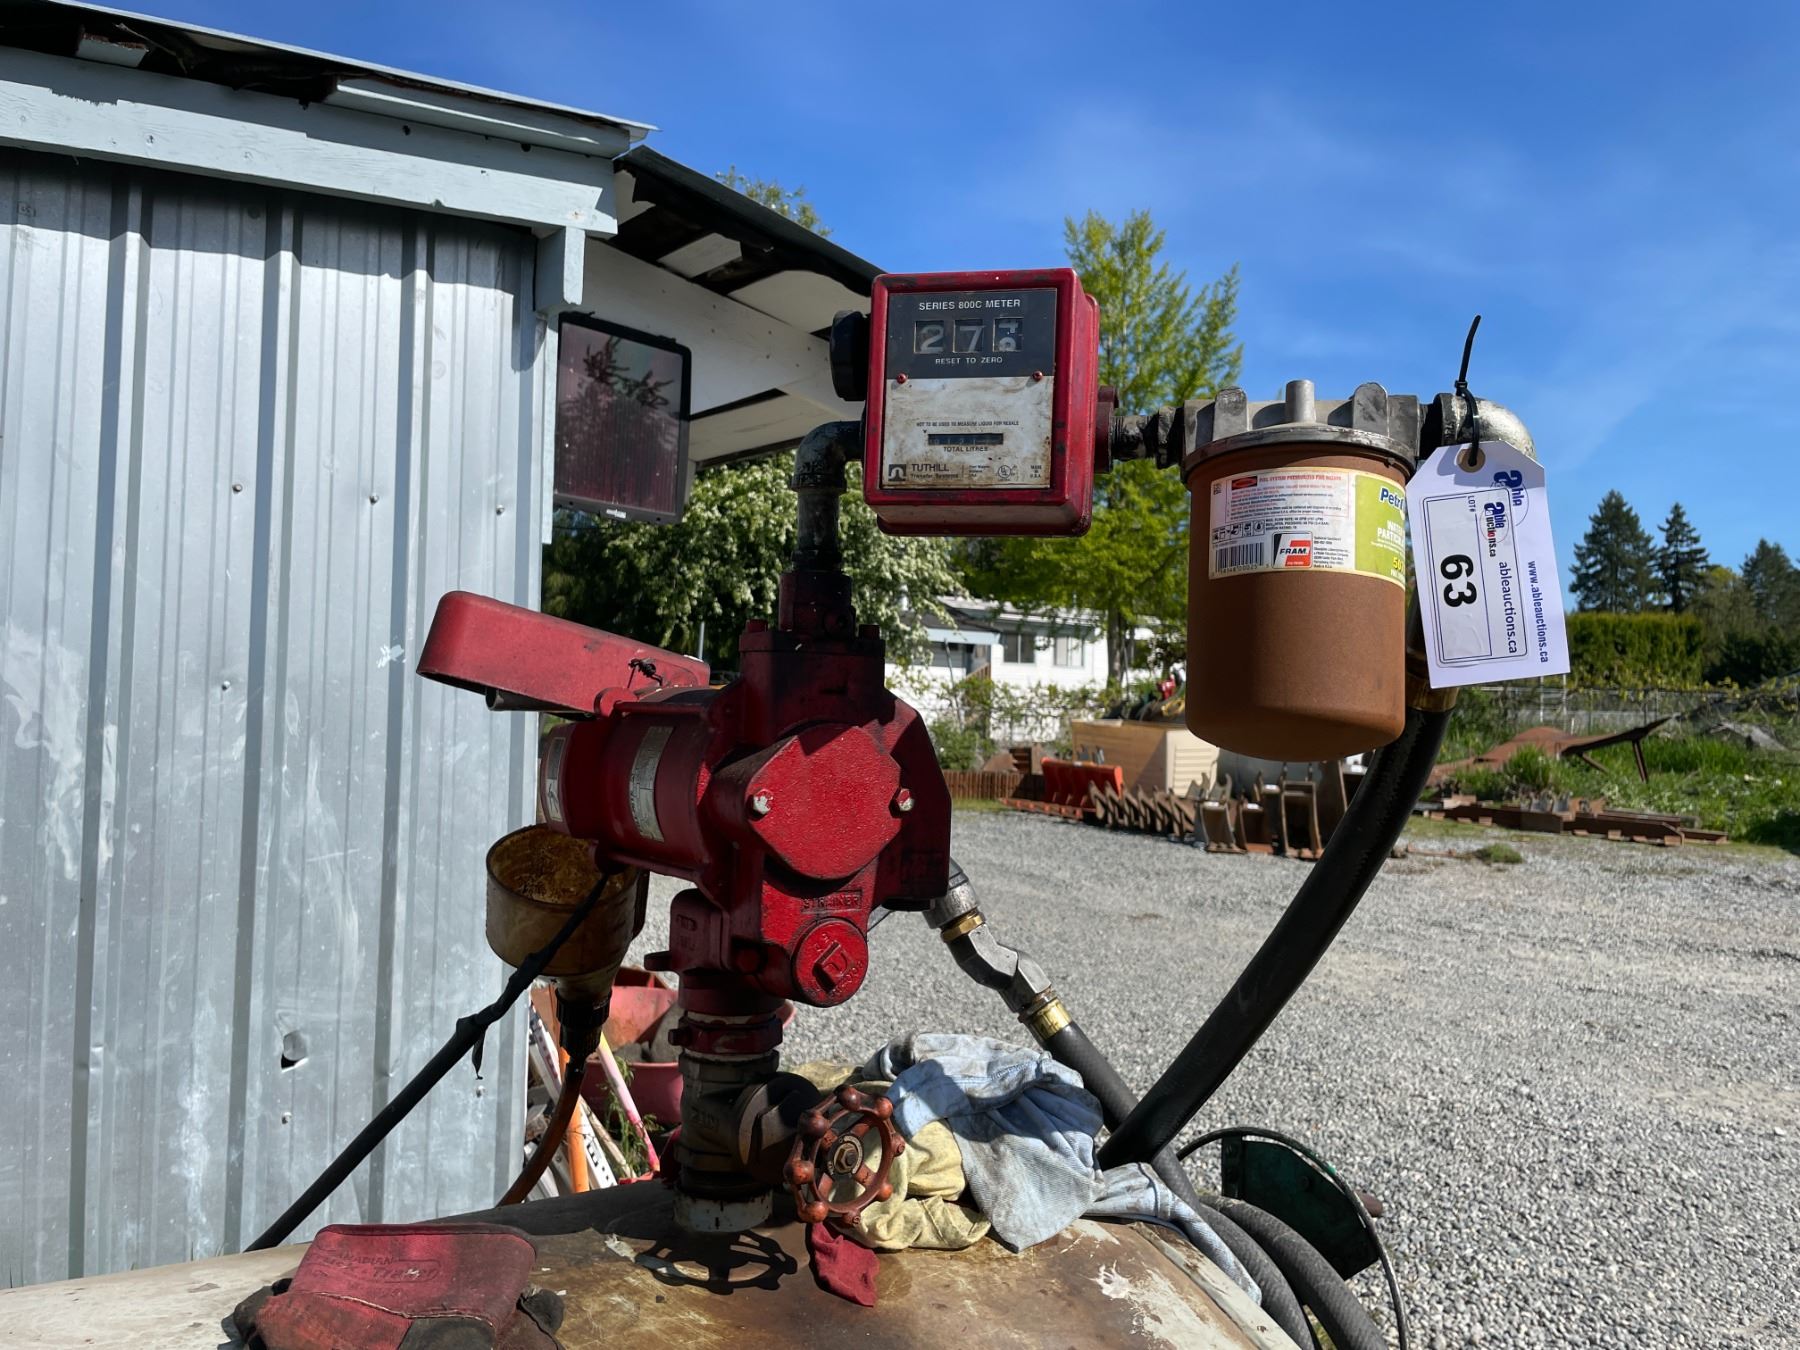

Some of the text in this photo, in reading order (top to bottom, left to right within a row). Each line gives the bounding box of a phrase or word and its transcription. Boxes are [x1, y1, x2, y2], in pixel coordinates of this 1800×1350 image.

[919, 299, 1021, 311] SERIES 800C METER
[935, 357, 961, 365] RESET
[980, 356, 1003, 364] ZERO
[911, 463, 950, 472] TUTHILL
[1467, 496, 1476, 512] LOT#
[1441, 554, 1477, 608] 63
[1499, 561, 1518, 654] ableauctions.ca
[1528, 560, 1549, 663] www.ableauctions.ca
